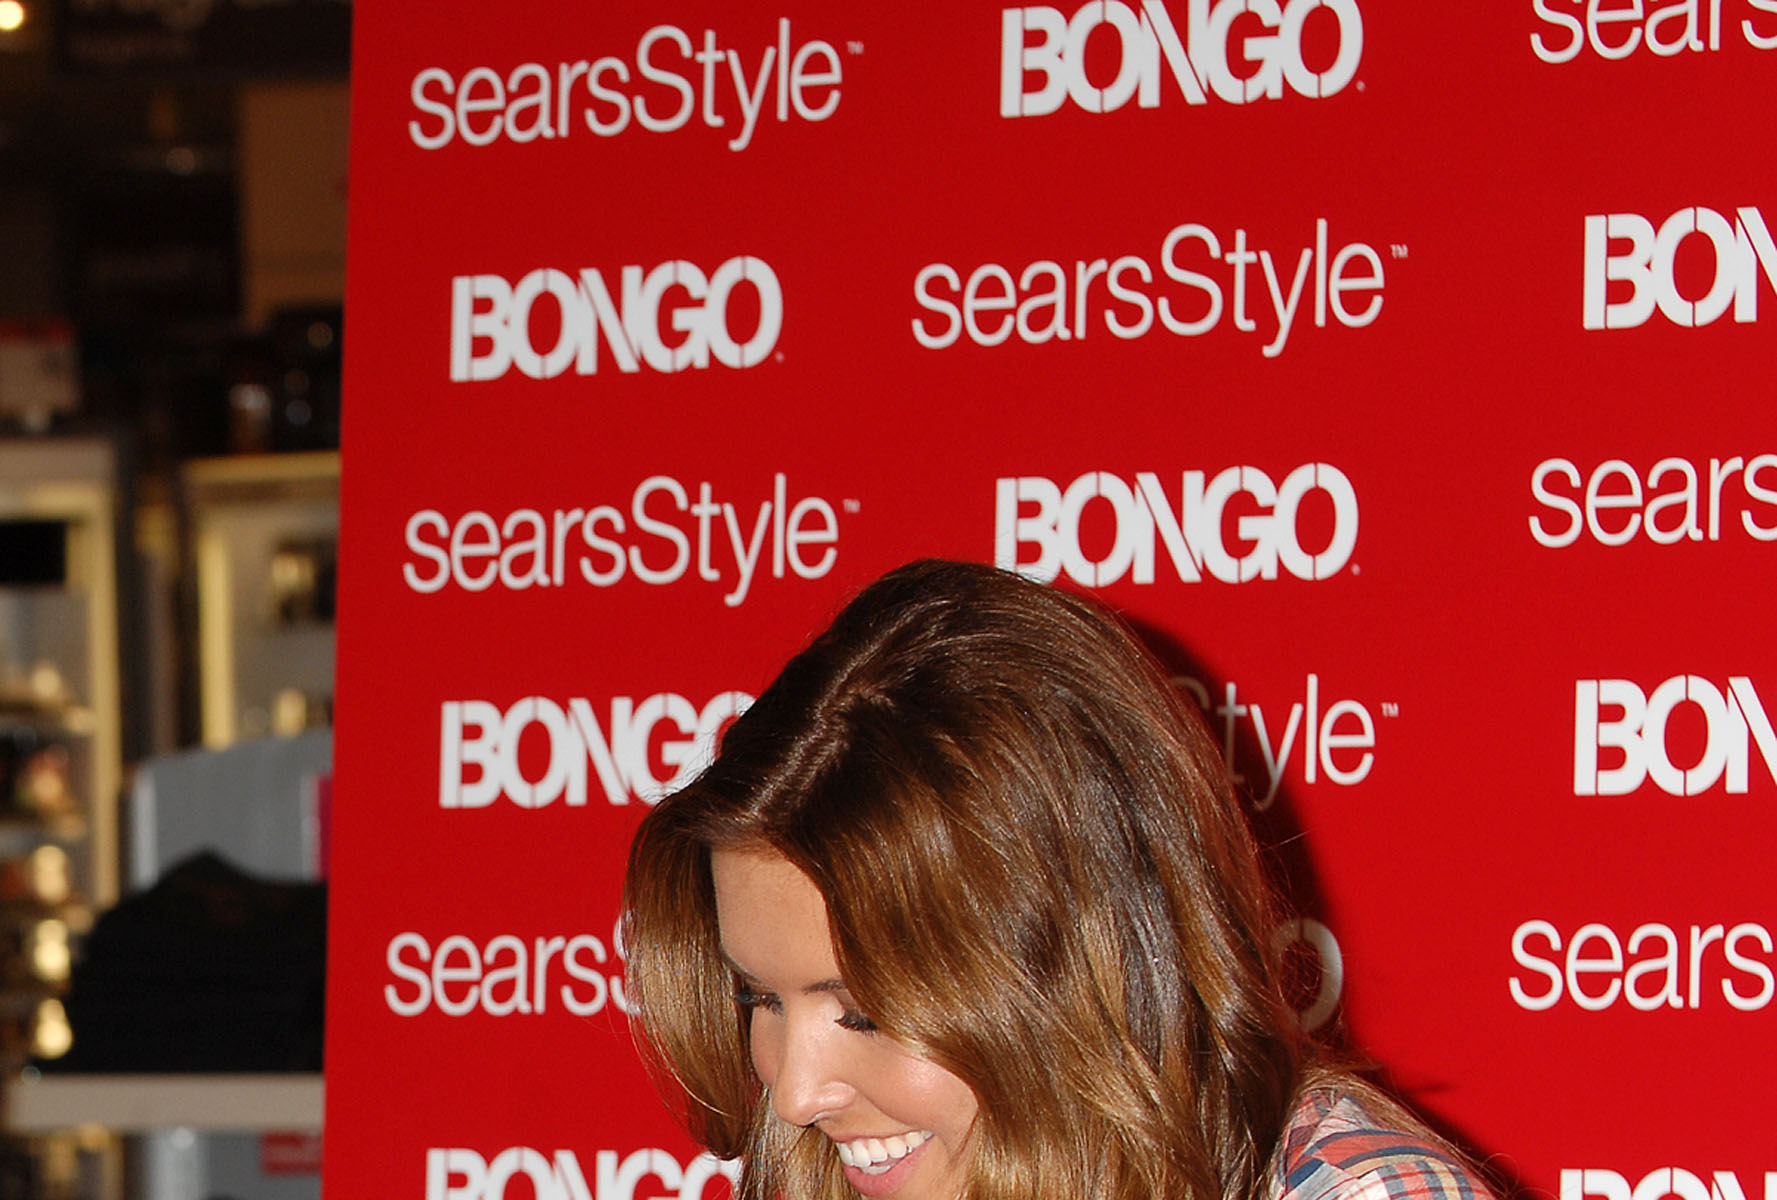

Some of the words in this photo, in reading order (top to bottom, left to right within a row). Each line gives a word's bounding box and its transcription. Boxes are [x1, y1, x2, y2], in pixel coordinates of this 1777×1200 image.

[409, 17, 843, 151] searsStyle
[1001, 0, 1364, 118] BONGO
[450, 256, 783, 382] BONGO
[911, 217, 1385, 358] searsStyle
[403, 472, 838, 607] searsStyle
[995, 463, 1360, 588] BONGO
[1168, 673, 1376, 812] tyle
[1574, 674, 1777, 797] BON
[384, 910, 642, 1017] sears
